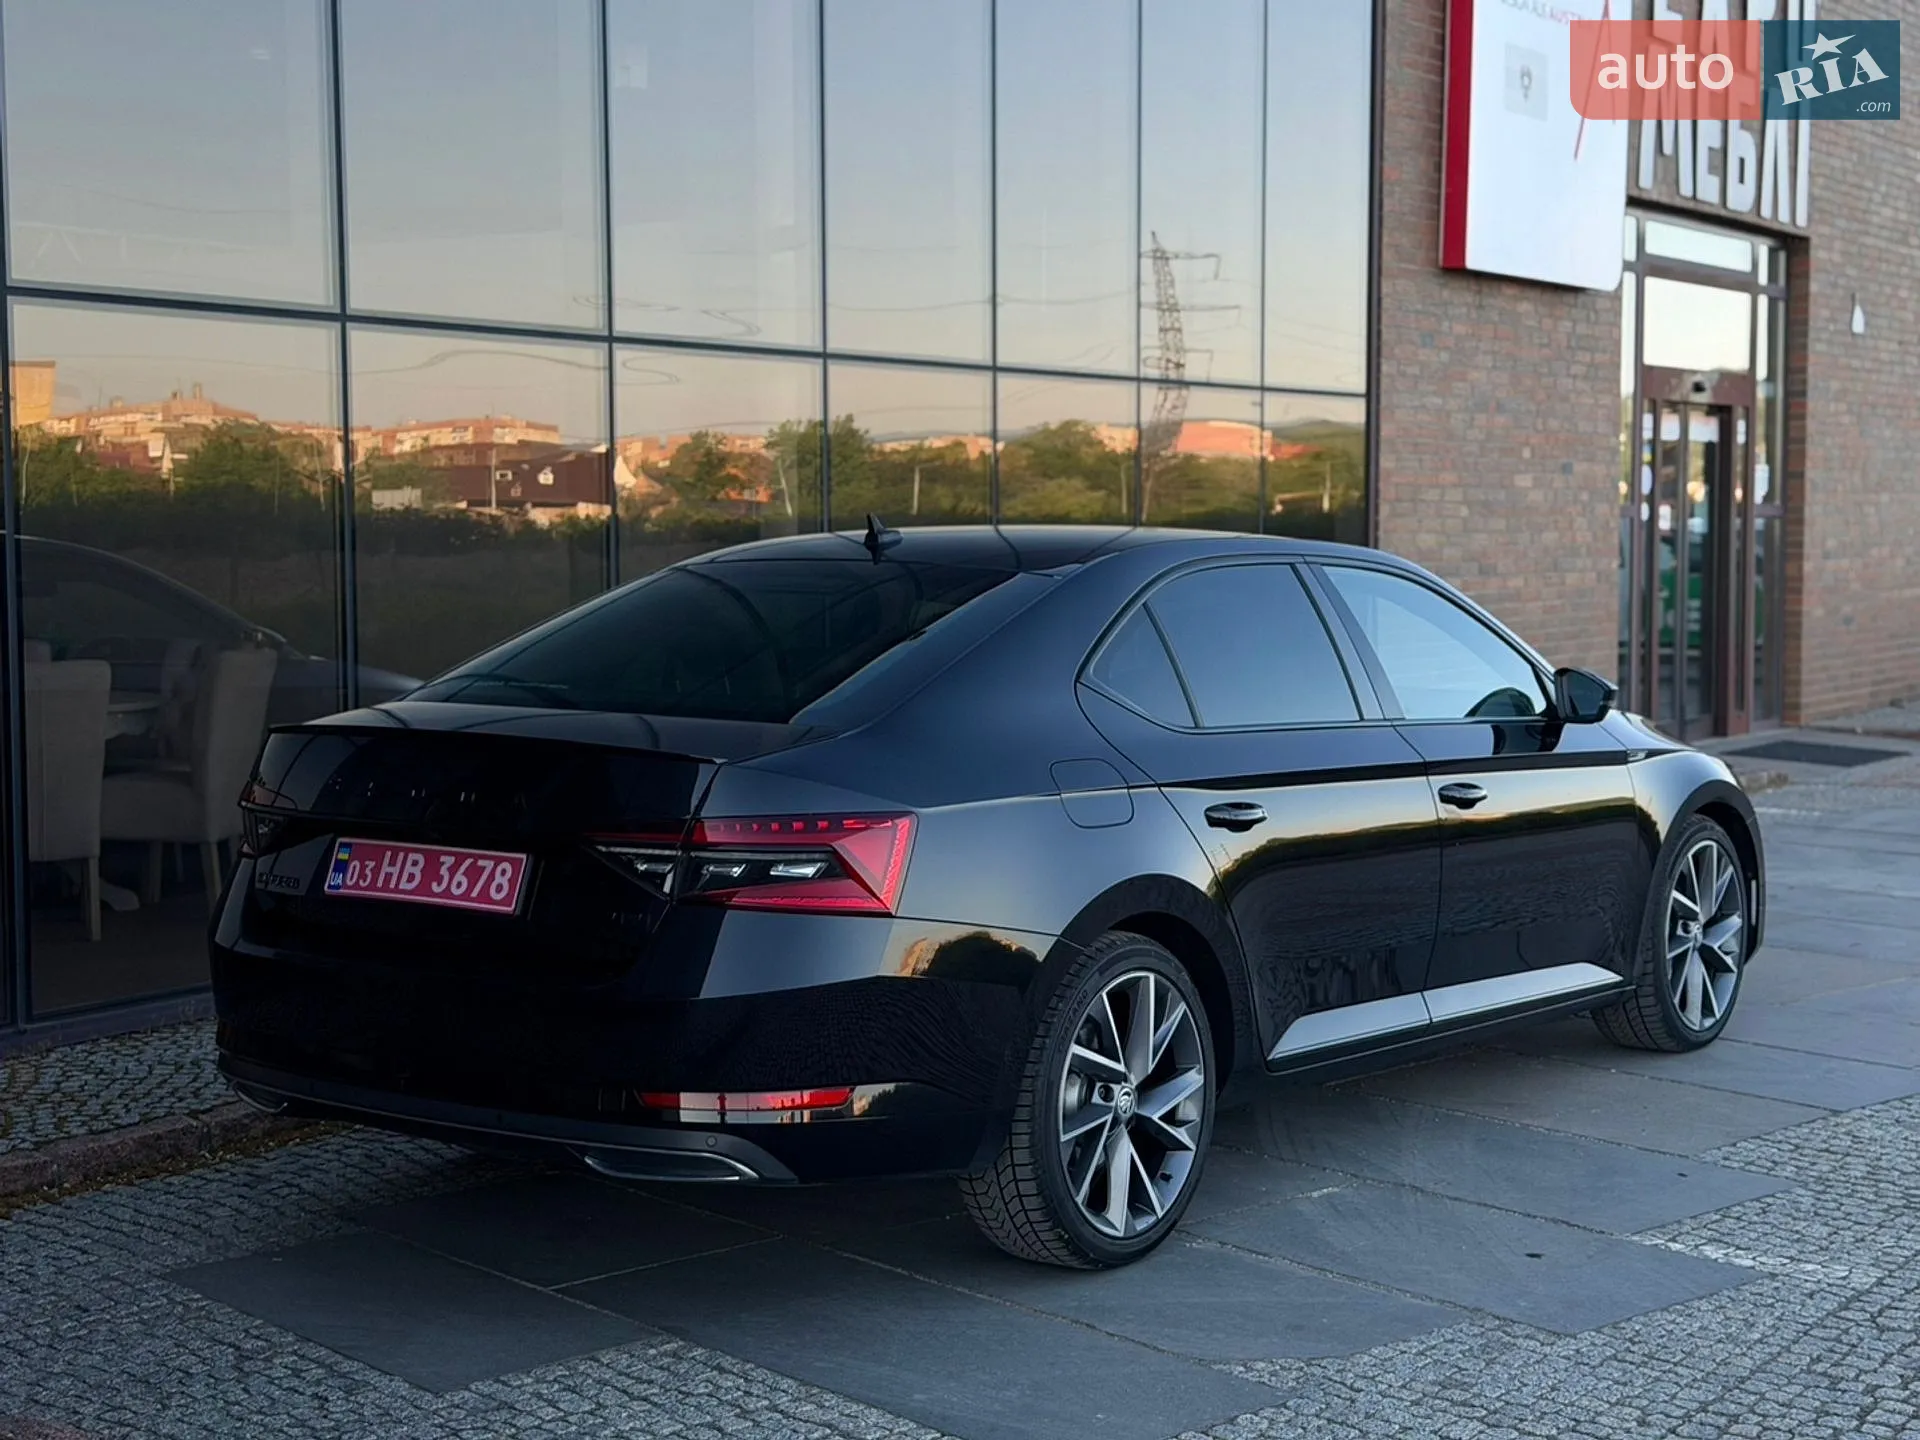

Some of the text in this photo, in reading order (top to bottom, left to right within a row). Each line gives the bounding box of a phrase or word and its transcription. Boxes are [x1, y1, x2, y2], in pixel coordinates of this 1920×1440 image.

[330, 871, 343, 886] UA
[346, 860, 376, 887] 03
[376, 850, 425, 891] HB
[431, 855, 512, 900] 3678
